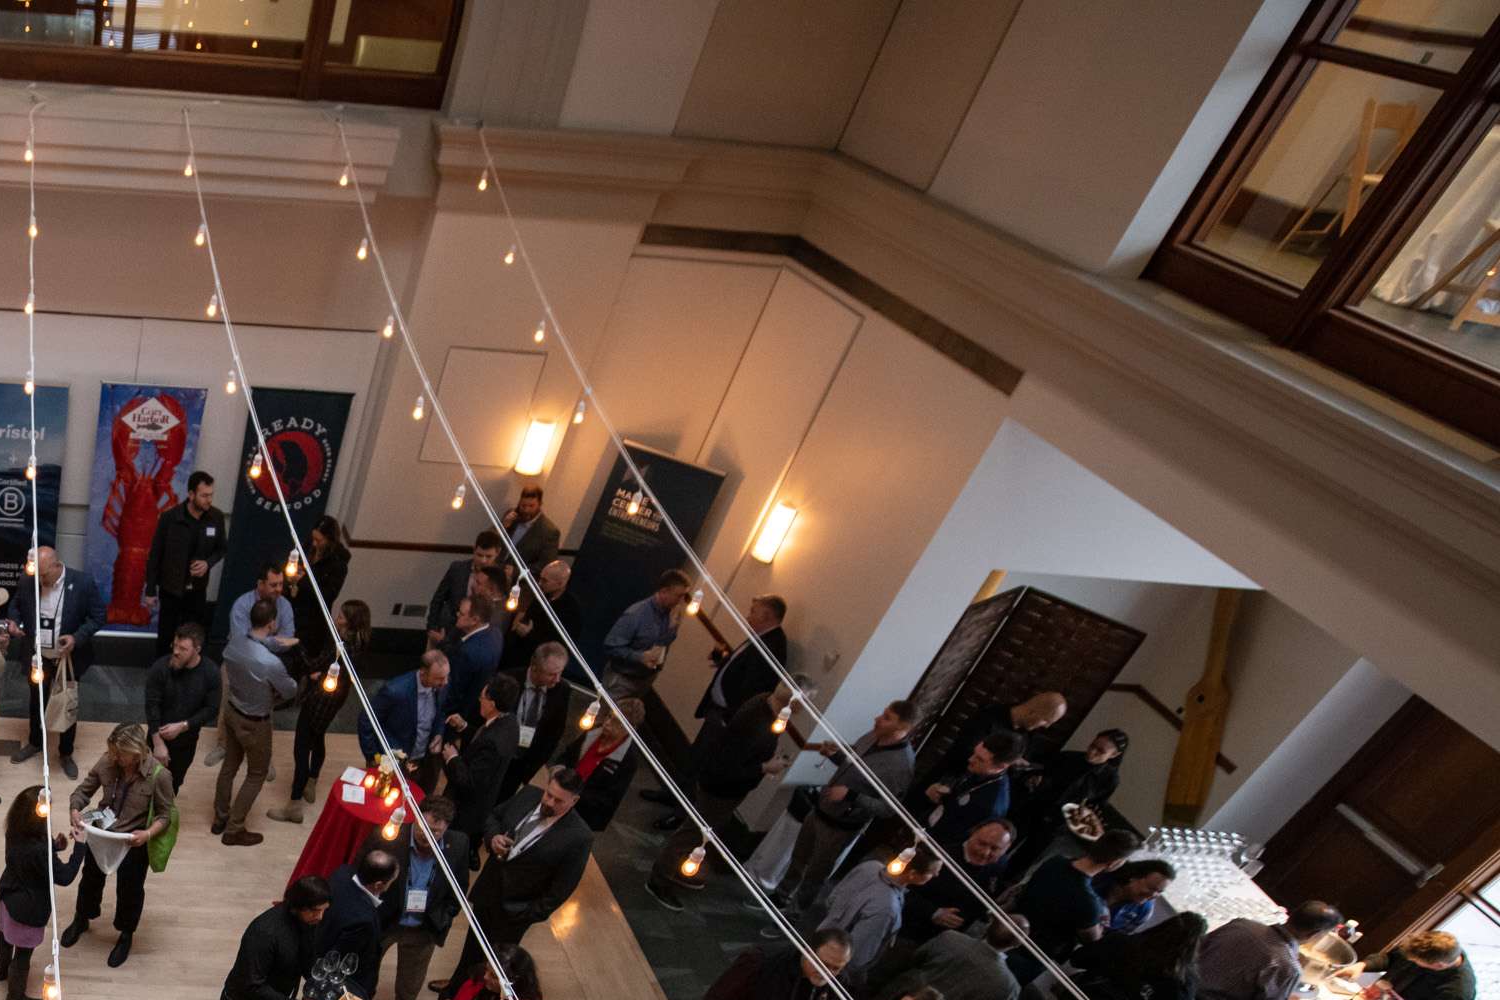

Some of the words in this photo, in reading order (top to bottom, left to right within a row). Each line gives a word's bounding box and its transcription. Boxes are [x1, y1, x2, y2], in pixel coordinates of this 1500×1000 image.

[261, 416, 327, 440] READY
[3, 492, 18, 510] B
[615, 487, 650, 507] MAE
[612, 498, 653, 518] CEER
